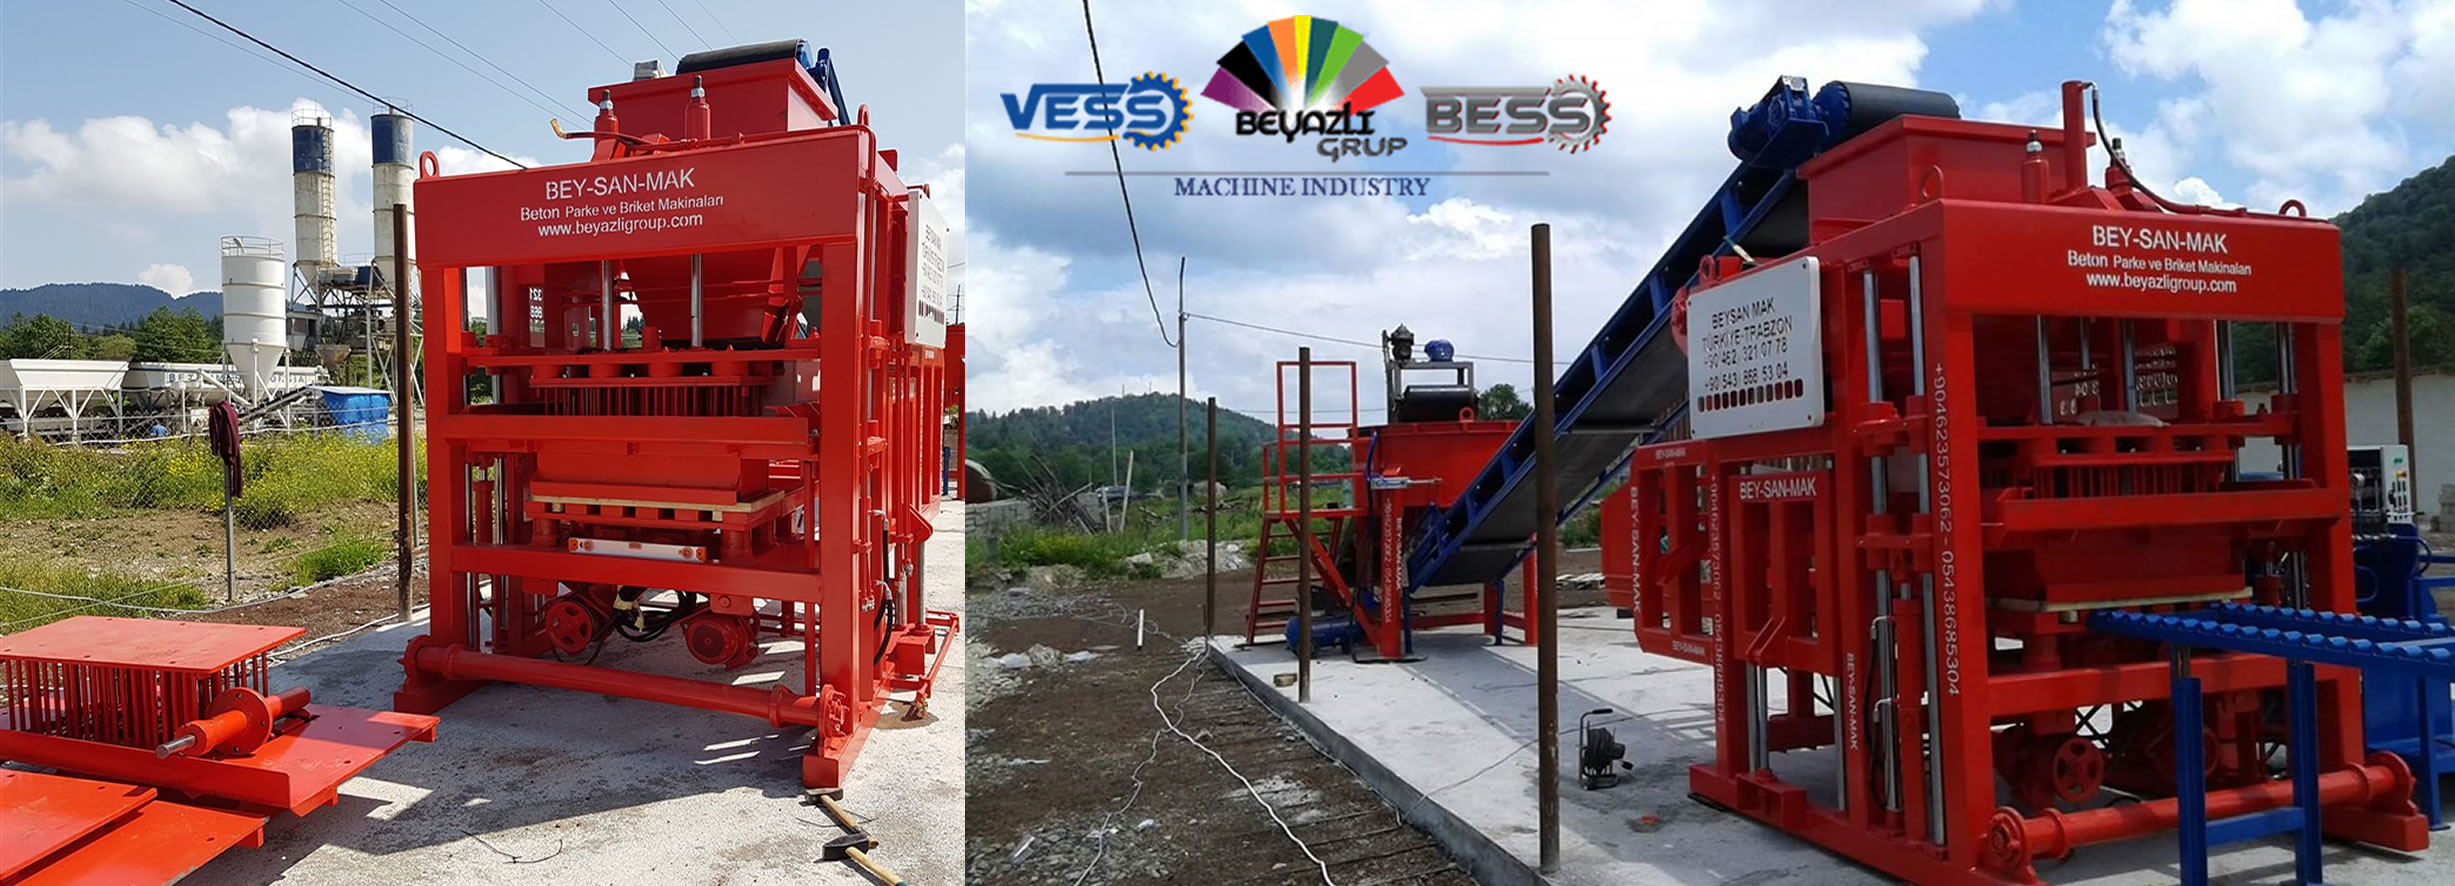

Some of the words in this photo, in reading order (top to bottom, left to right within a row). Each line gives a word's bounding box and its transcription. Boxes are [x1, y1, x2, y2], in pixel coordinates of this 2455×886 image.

[546, 167, 695, 200] BEY-SAN-MAK
[521, 207, 560, 221] Beton
[565, 204, 599, 219] Parke
[602, 205, 616, 215] ve
[620, 198, 655, 214] Briket
[658, 195, 724, 211] Makinaları
[538, 213, 703, 237] www.beyazligroup.com
[2093, 225, 2229, 254] BEY-SAN-MAK
[2067, 249, 2108, 268] Beton
[2113, 254, 2146, 270] Parke
[2149, 259, 2162, 271] ve
[2165, 257, 2196, 273] Briket
[2086, 272, 2237, 294] www.beyazligroup.com
[1712, 304, 1750, 329] BEYSAN
[1751, 297, 1775, 318] MAK
[1775, 337, 1788, 353] 78
[1762, 364, 1774, 381] 53
[1776, 361, 1789, 379] 04
[1740, 477, 1817, 499] BEY-SAN-MAK
[1631, 487, 1641, 613] BEY-SAN-MAK
